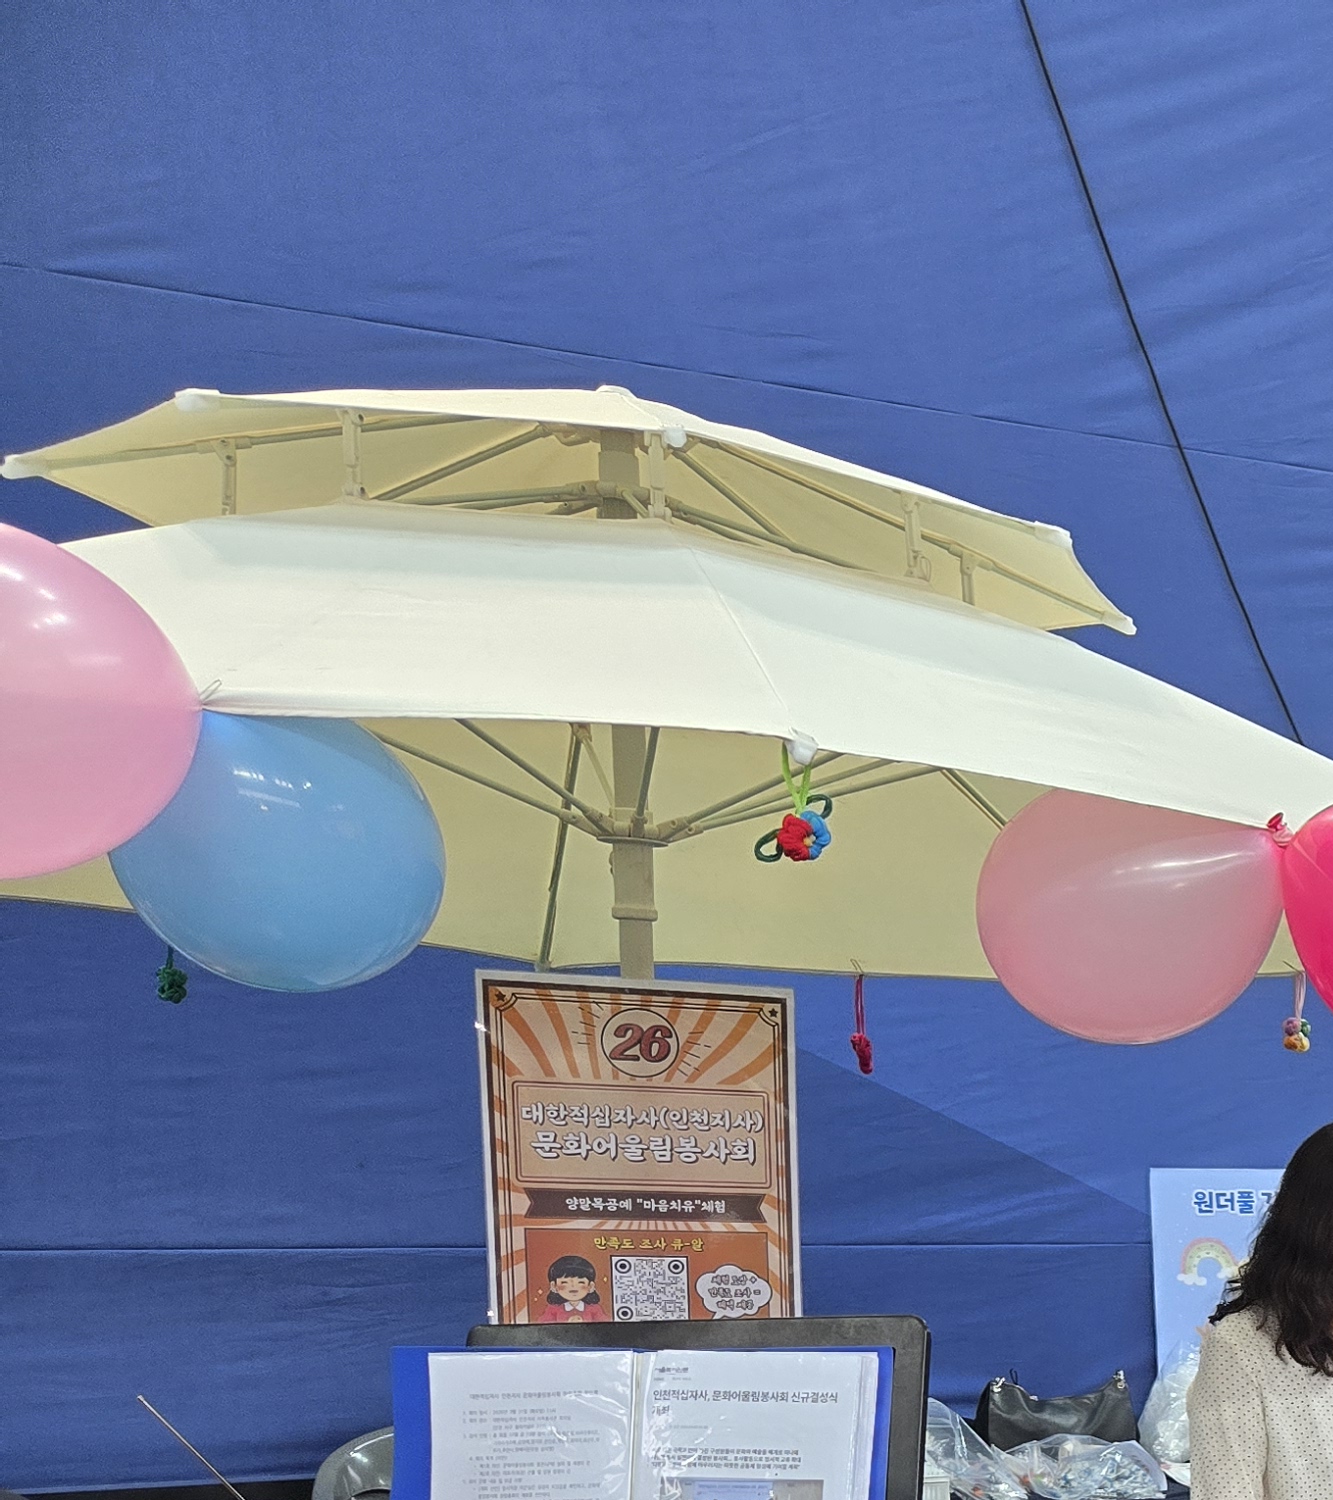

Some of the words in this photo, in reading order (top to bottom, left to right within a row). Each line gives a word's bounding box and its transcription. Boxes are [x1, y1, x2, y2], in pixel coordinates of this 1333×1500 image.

[609, 1023, 673, 1063] 26
[521, 1101, 764, 1133] 대한적십자사(인천지사)
[531, 1131, 757, 1166] 문화어울림봉사회
[565, 1197, 633, 1212] 양말목공예
[1193, 1191, 1255, 1214] 원더풀
[594, 1236, 635, 1250] 만족도
[639, 1237, 667, 1250] 조사
[653, 1390, 710, 1402] 인천적십자사,
[712, 1391, 789, 1403] 문화어울림봉사회
[791, 1391, 838, 1404] 신규결성식
